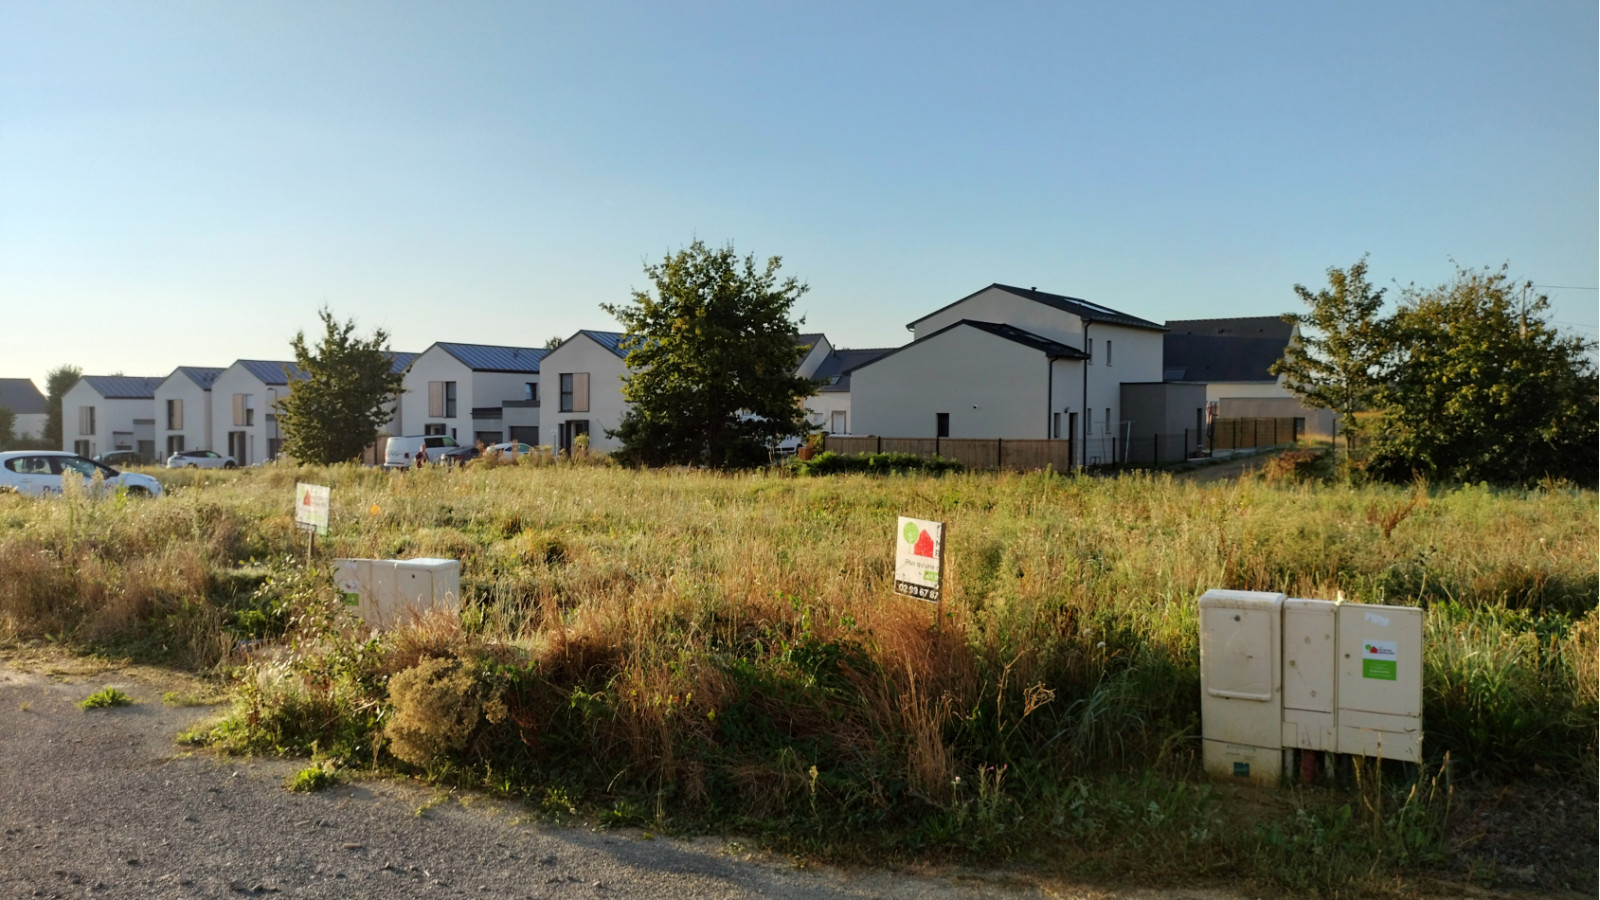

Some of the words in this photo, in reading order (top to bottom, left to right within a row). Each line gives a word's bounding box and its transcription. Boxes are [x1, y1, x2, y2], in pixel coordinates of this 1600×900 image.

[898, 583, 908, 593] 02
[908, 585, 919, 595] 99
[919, 587, 929, 598] 67
